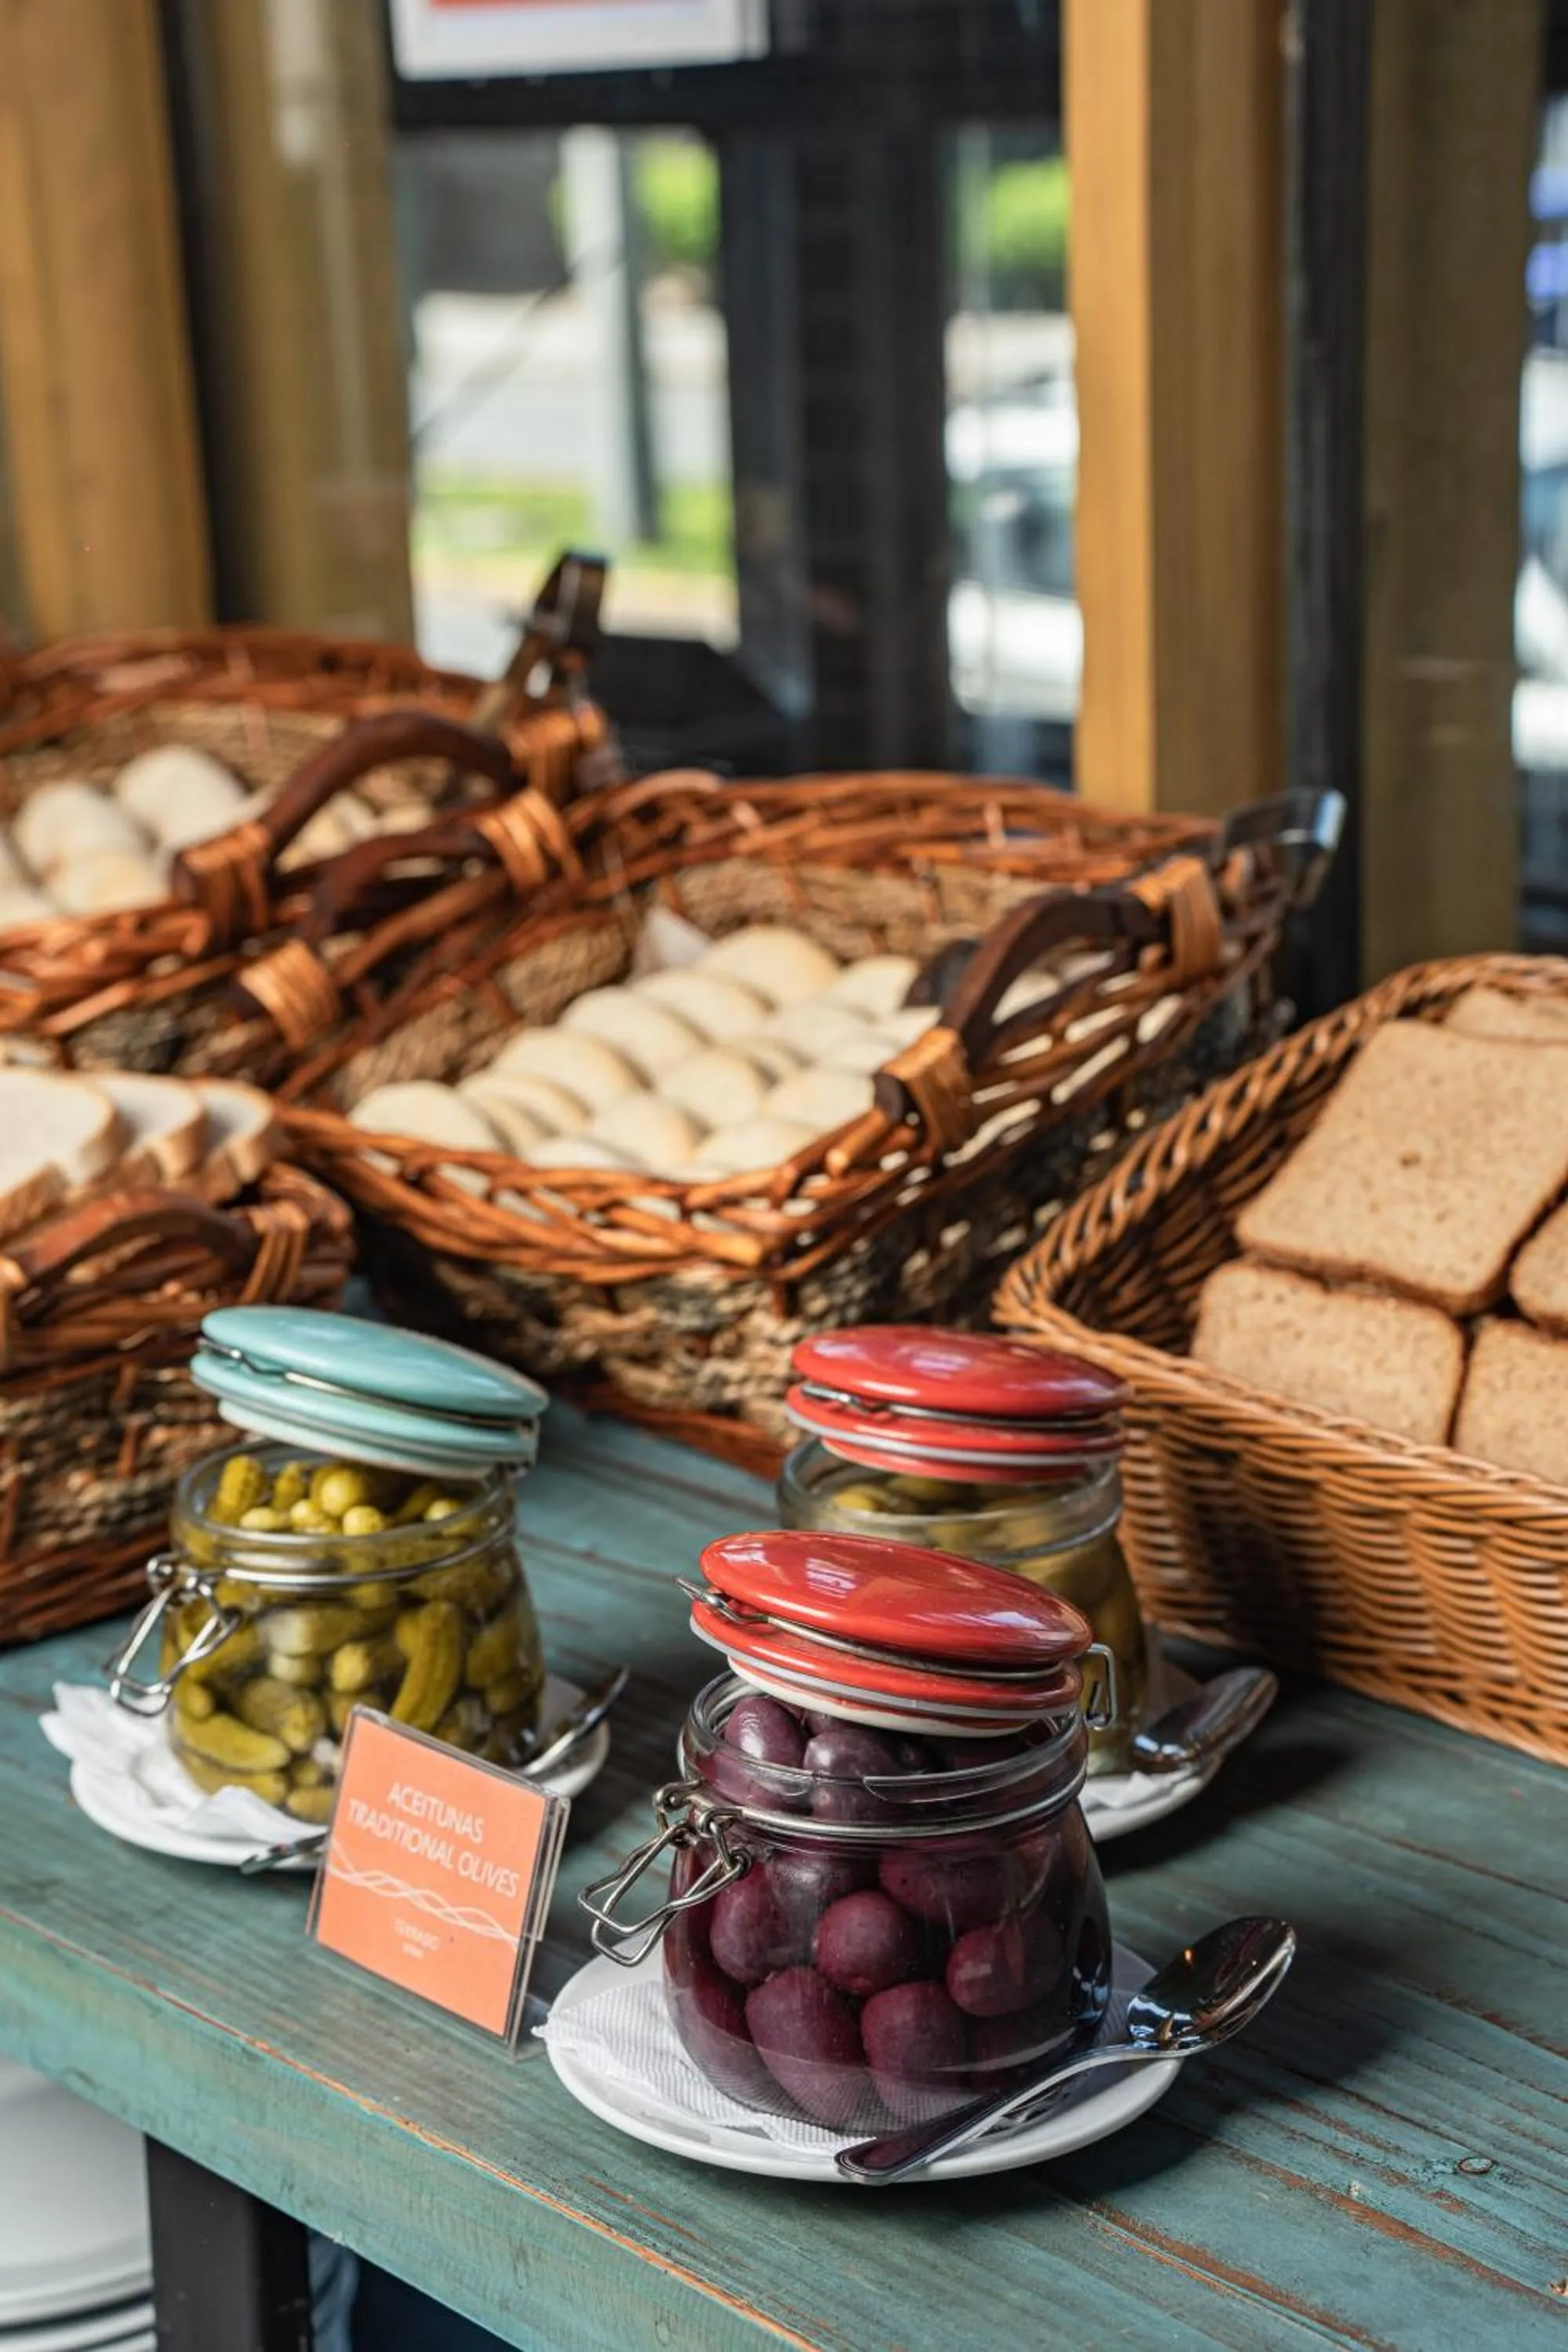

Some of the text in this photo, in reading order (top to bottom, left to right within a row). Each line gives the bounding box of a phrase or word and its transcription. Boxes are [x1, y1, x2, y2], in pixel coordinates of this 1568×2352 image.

[349, 1799, 520, 1898] TRADITIONAL OLIVES
[389, 1783, 485, 1843] ACEITUNAS
